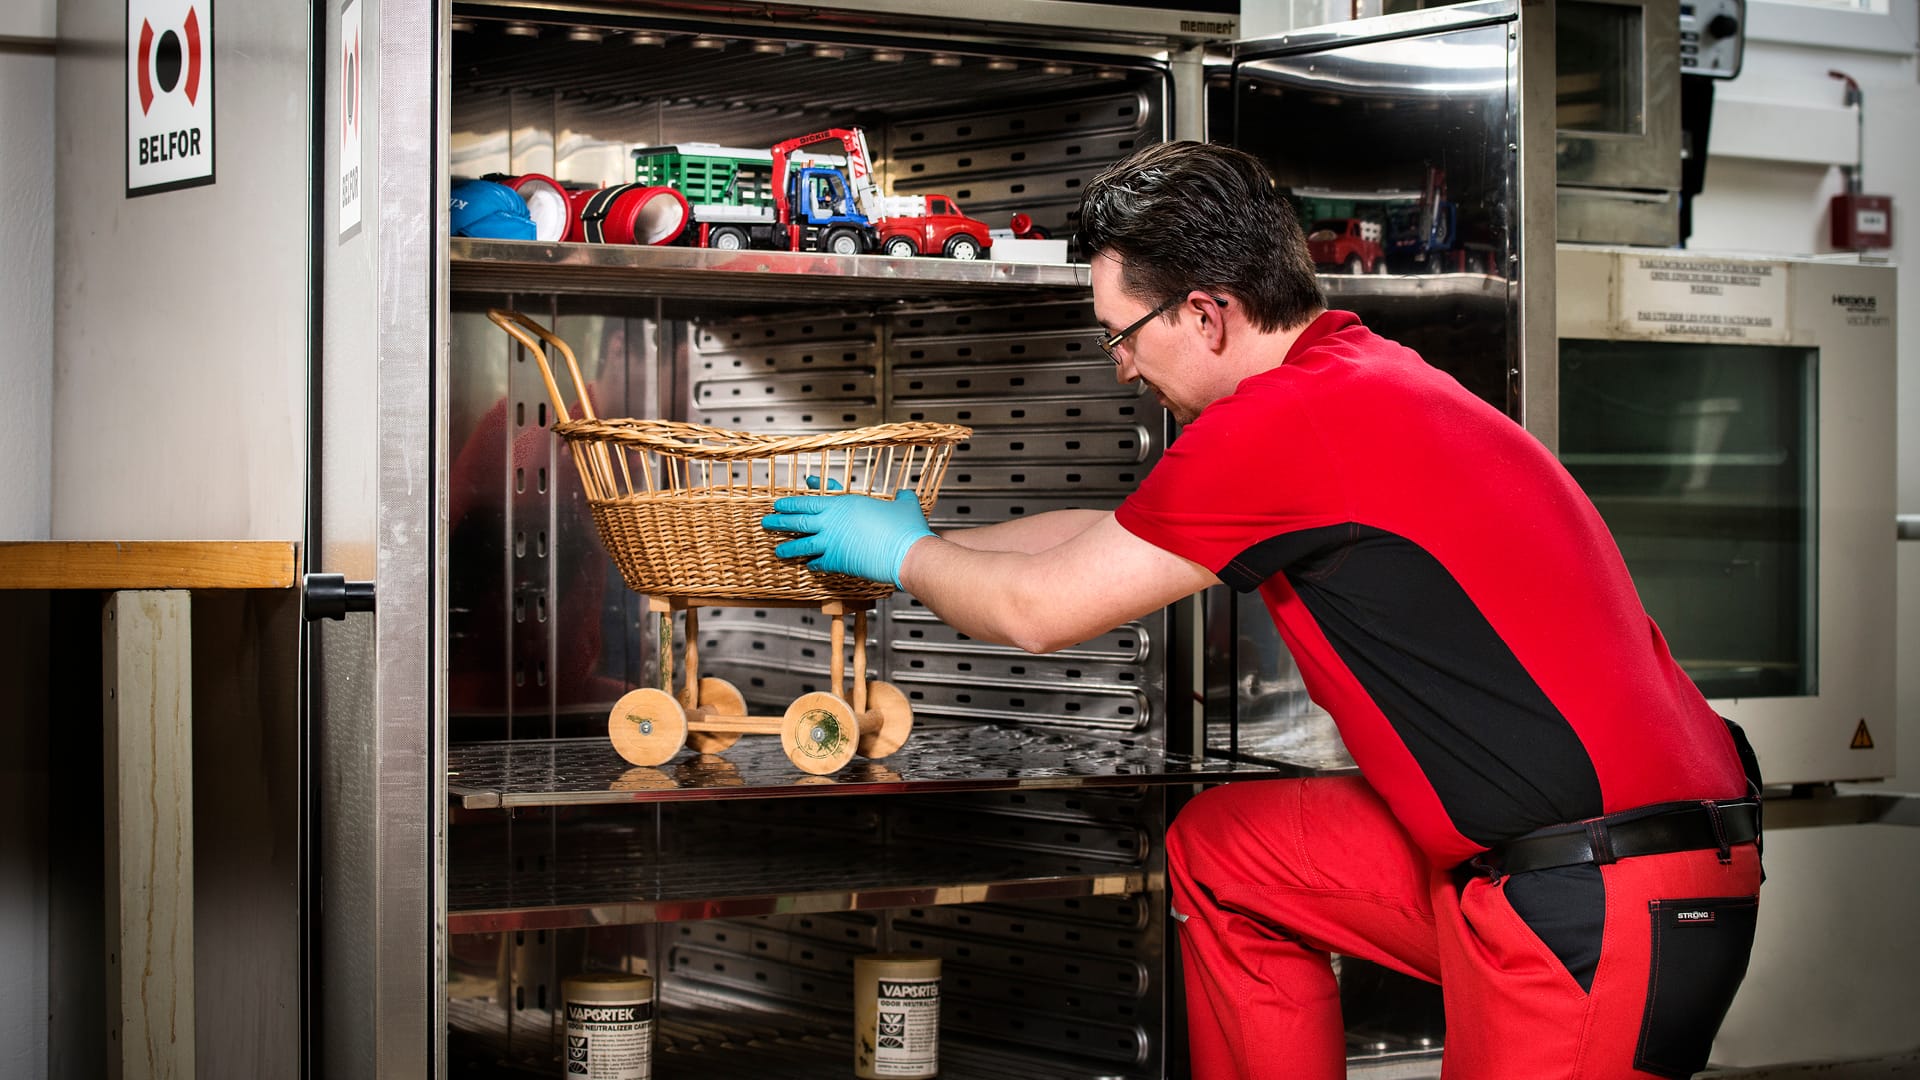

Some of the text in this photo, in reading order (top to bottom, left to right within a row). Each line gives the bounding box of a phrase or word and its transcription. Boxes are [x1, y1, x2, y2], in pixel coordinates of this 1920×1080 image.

[1181, 20, 1236, 35] memmert
[800, 131, 831, 144] DICKIE
[139, 128, 201, 166] BELFOR
[1677, 911, 1709, 919] STRONG
[569, 1007, 634, 1021] VAPORTEK
